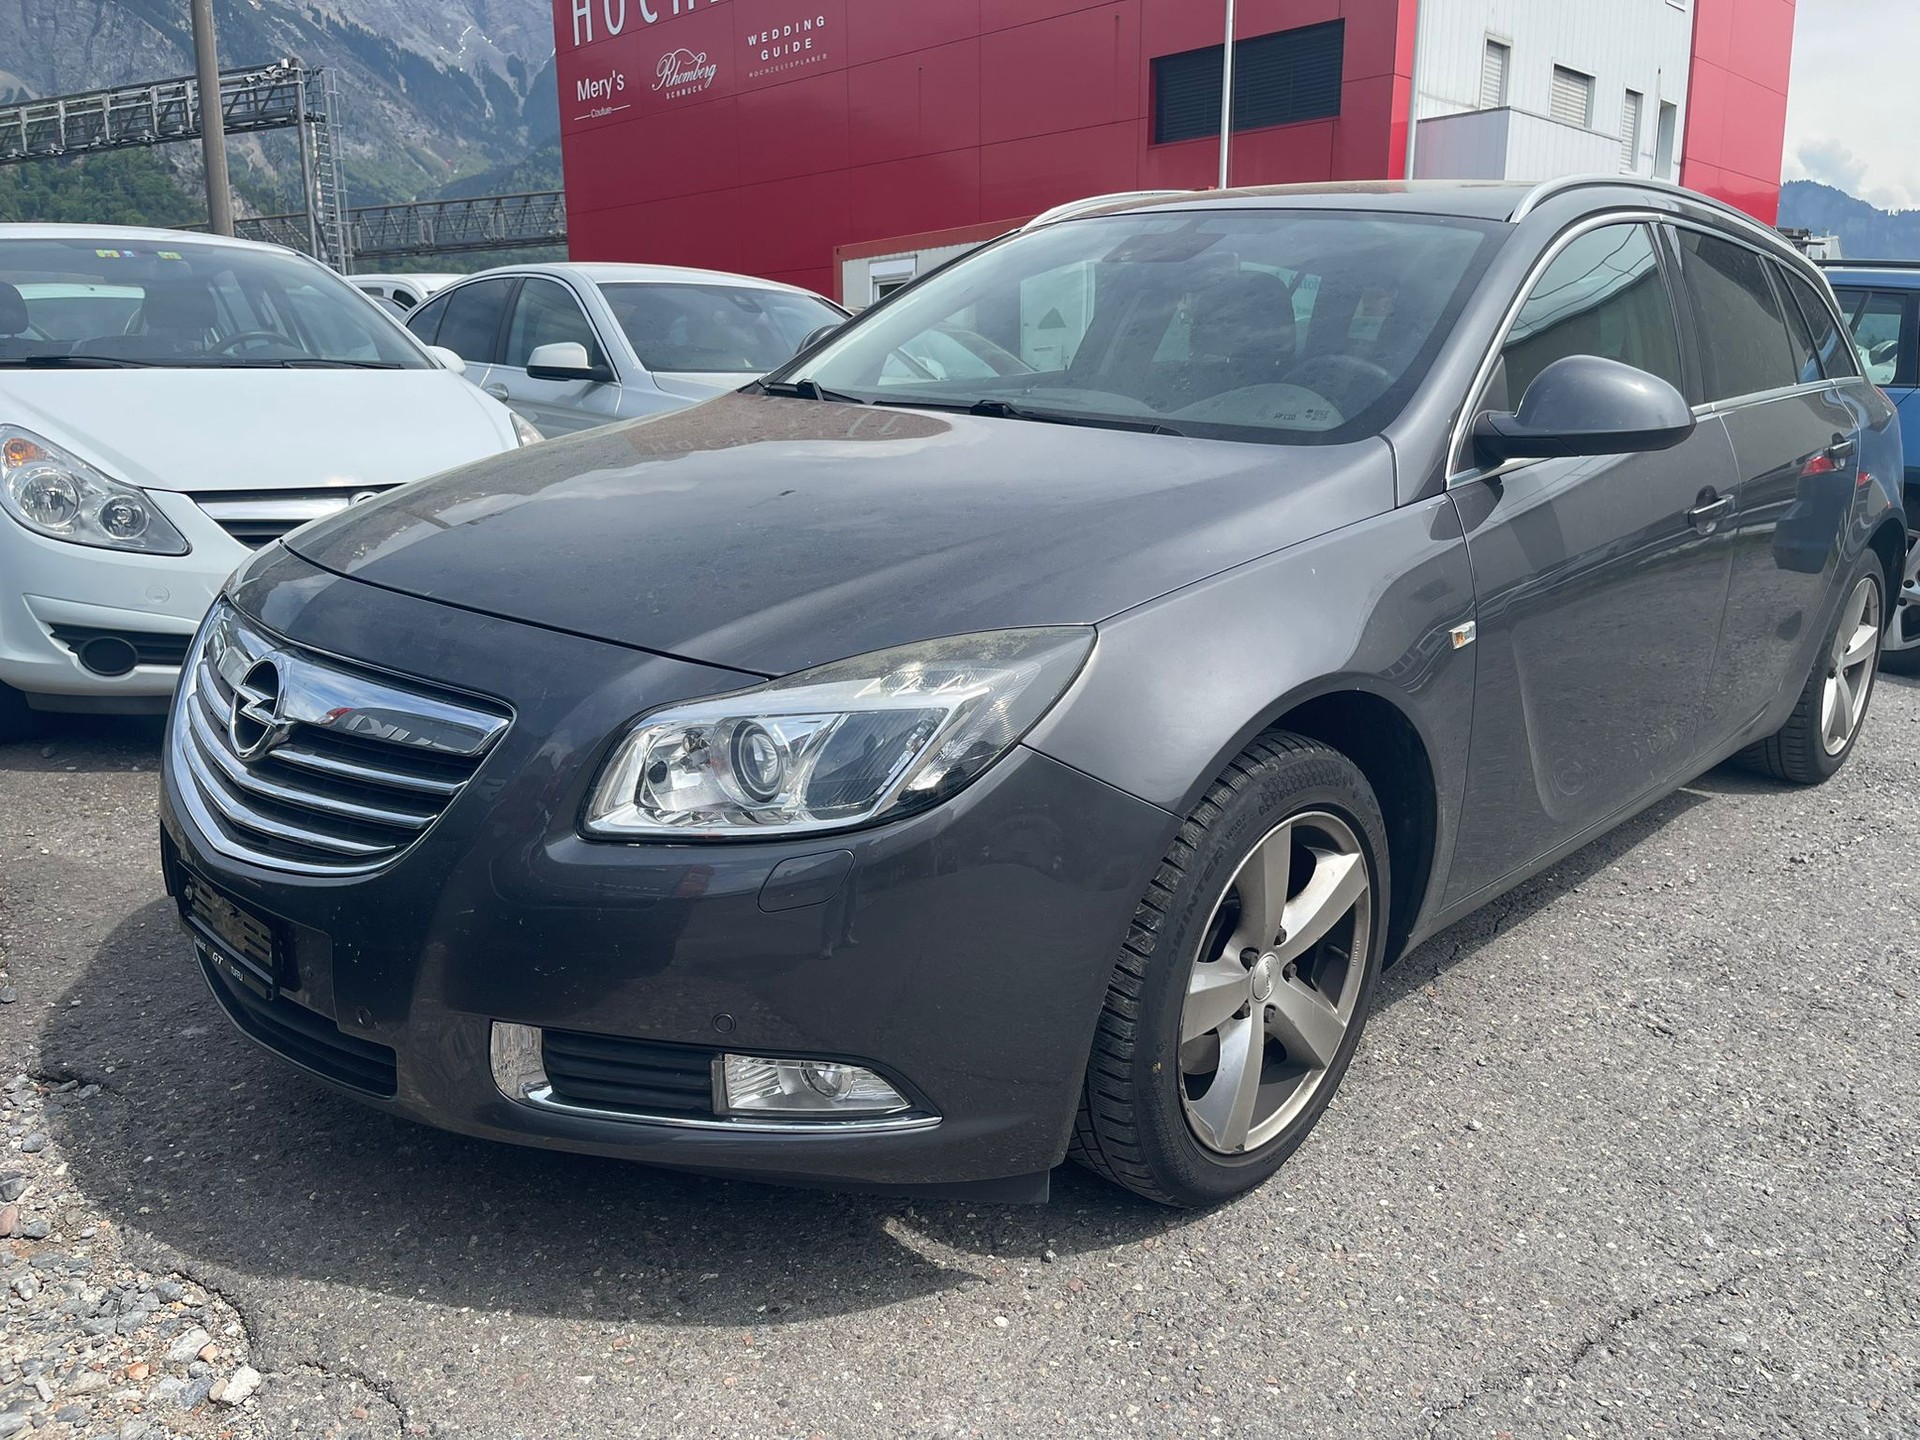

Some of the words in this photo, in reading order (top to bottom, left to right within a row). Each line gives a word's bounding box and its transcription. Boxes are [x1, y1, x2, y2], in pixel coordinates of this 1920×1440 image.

[747, 16, 825, 46] WEDDING
[761, 37, 812, 60] GUIDE
[652, 48, 717, 91] Rhomberg
[577, 69, 625, 102] Mery's
[212, 952, 223, 965] GT
